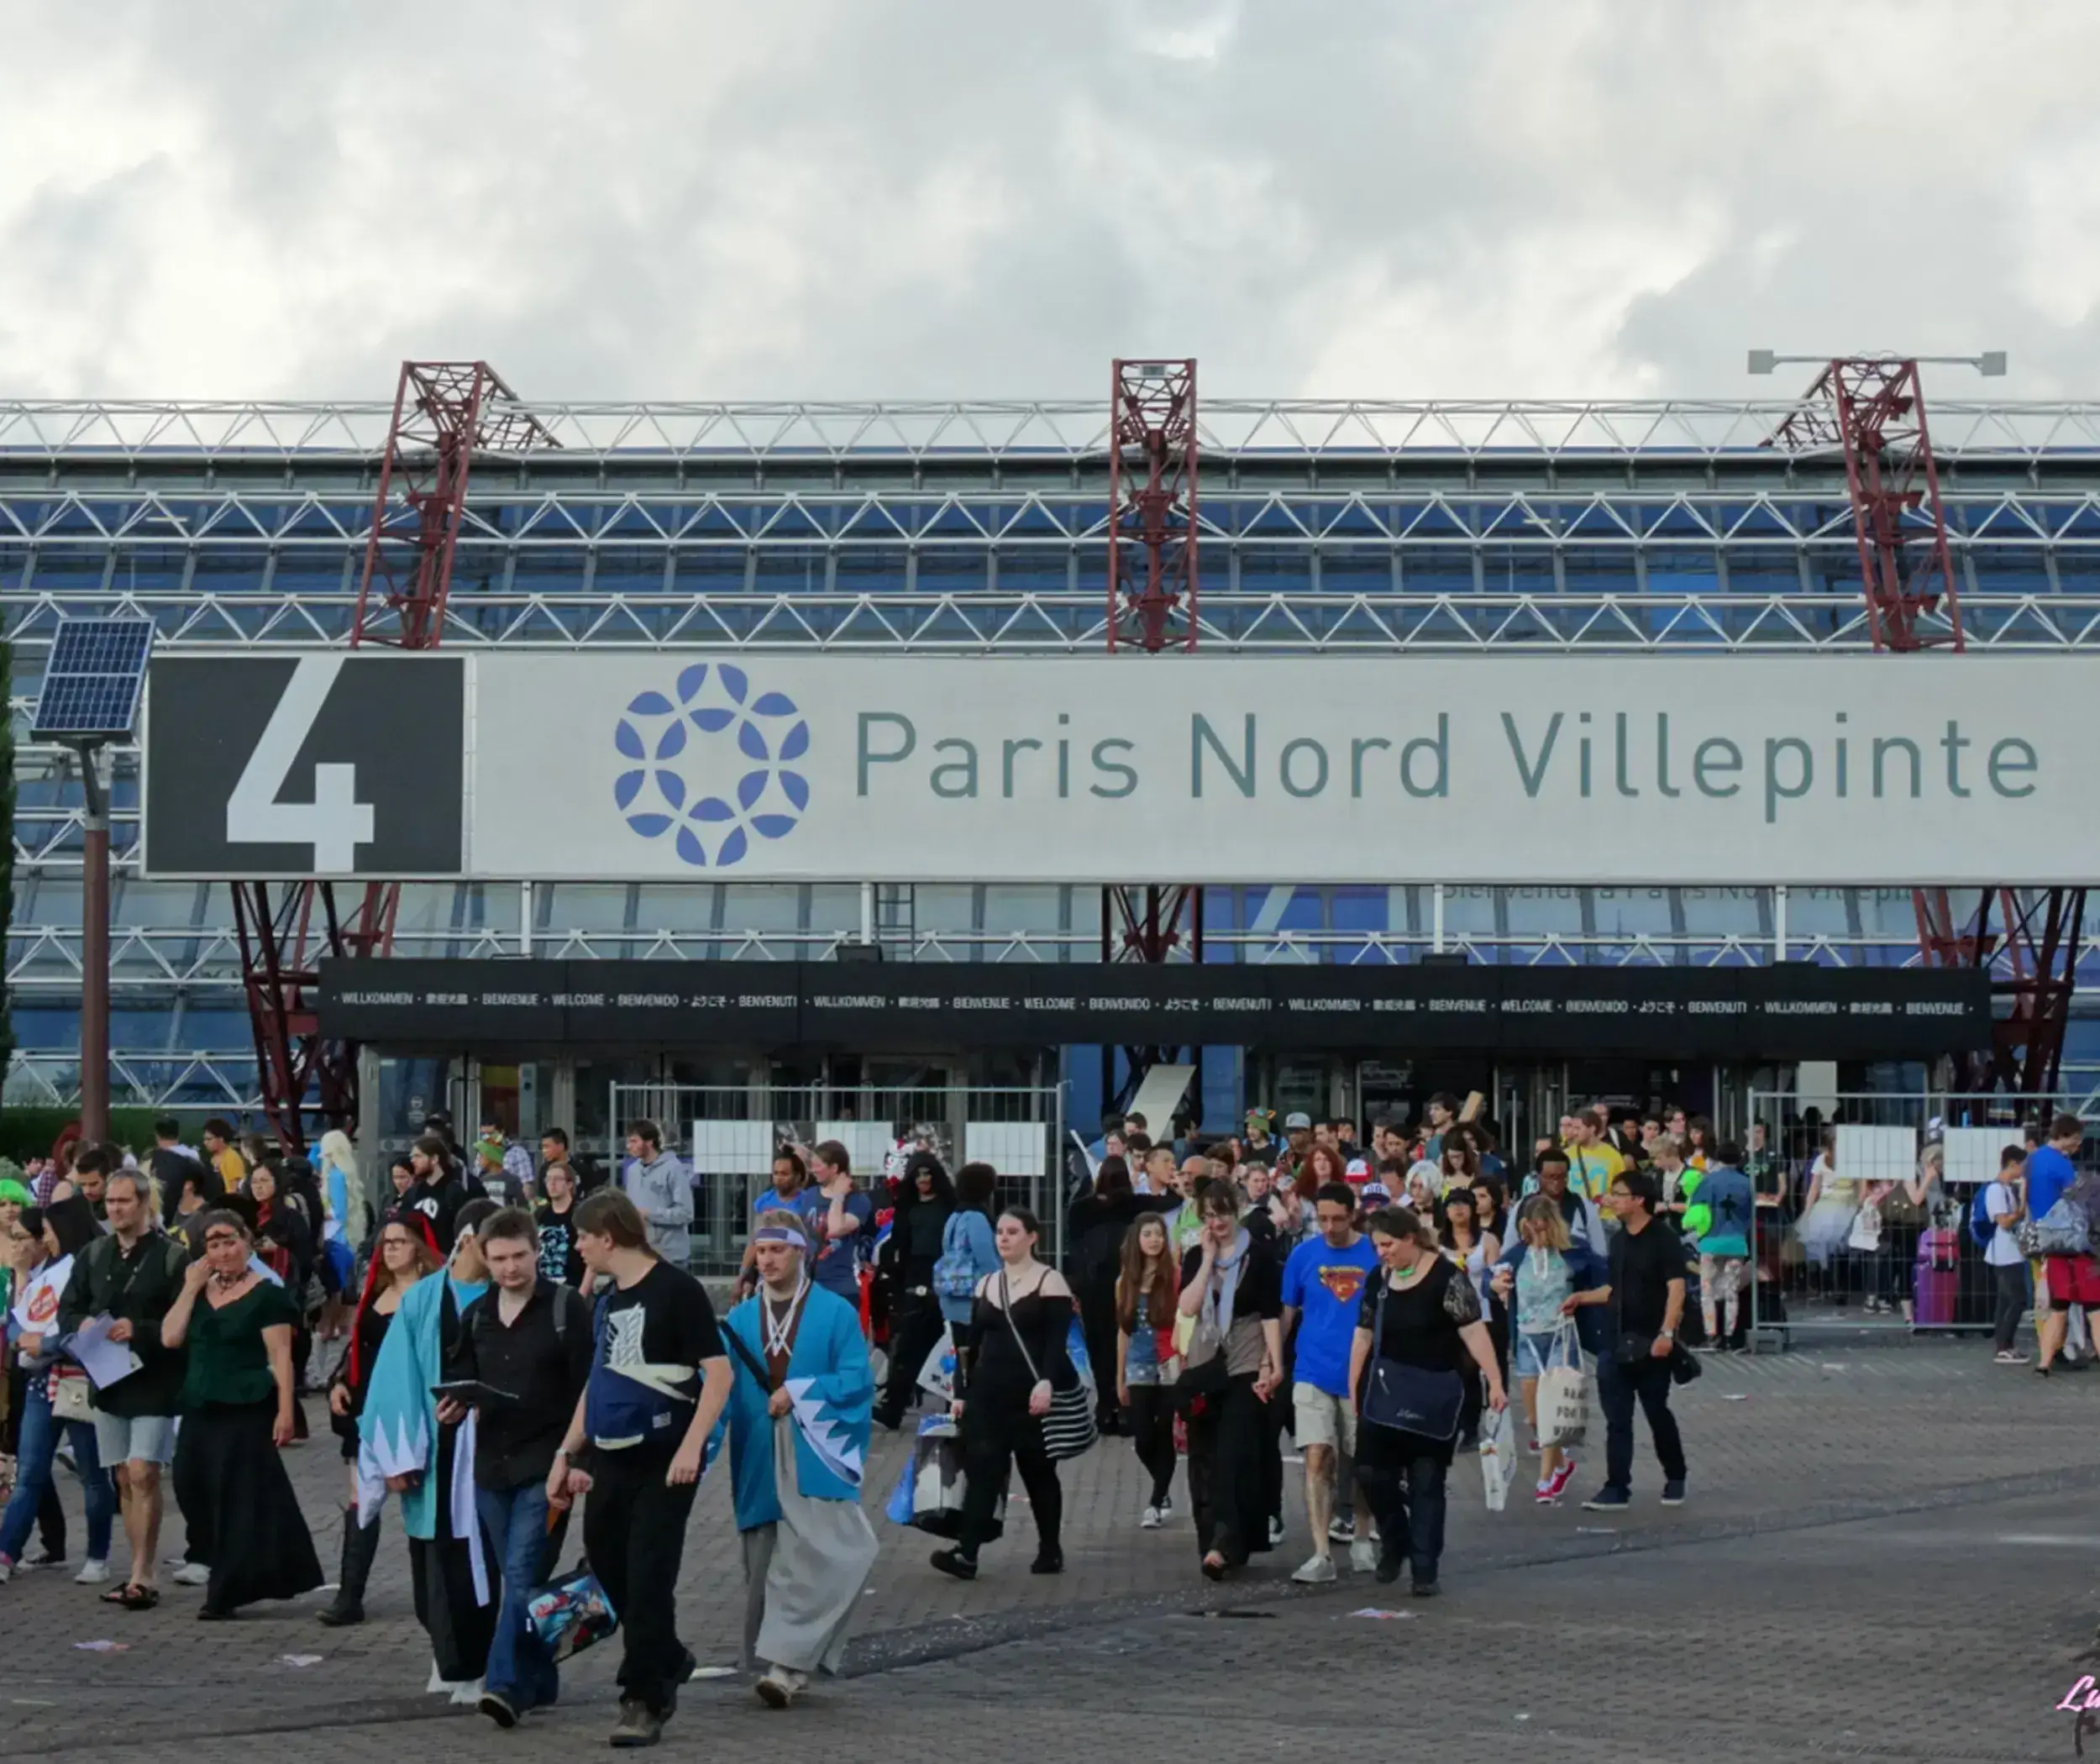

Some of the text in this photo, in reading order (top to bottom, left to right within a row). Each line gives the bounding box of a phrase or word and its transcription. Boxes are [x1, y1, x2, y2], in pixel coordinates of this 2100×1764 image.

[227, 657, 375, 874] 4
[857, 711, 2039, 824] Paris Nord Villepinte
[342, 992, 413, 1005] WILLKOMMEN
[482, 993, 539, 1005] BIENVENUE
[552, 994, 605, 1006] WELCOME
[617, 994, 680, 1007] BIENVENIDO
[690, 995, 727, 1008] ようこそ
[738, 995, 798, 1007] BENVENUTI
[813, 995, 886, 1008] WILLKOMMEN
[953, 996, 1011, 1009] BIENVENUE
[1024, 997, 1076, 1011] WELCOME
[1089, 998, 1152, 1011] BIENVENIDO
[1164, 998, 1201, 1011] ようこそ
[1213, 998, 1273, 1011] BENVENUTI
[1289, 999, 1362, 1011] WILLKOMMEN
[1429, 999, 1487, 1012] BIENVENUE
[1501, 1000, 1554, 1013] WELCOME
[1566, 1000, 1630, 1013] BIENVENIDO
[1639, 1000, 1676, 1014] ようこそ
[1688, 1001, 1748, 1014] BENVENUTI
[1765, 1001, 1838, 1015] WILLKOMMEN
[1906, 1002, 1965, 1015] BIENVENUE
